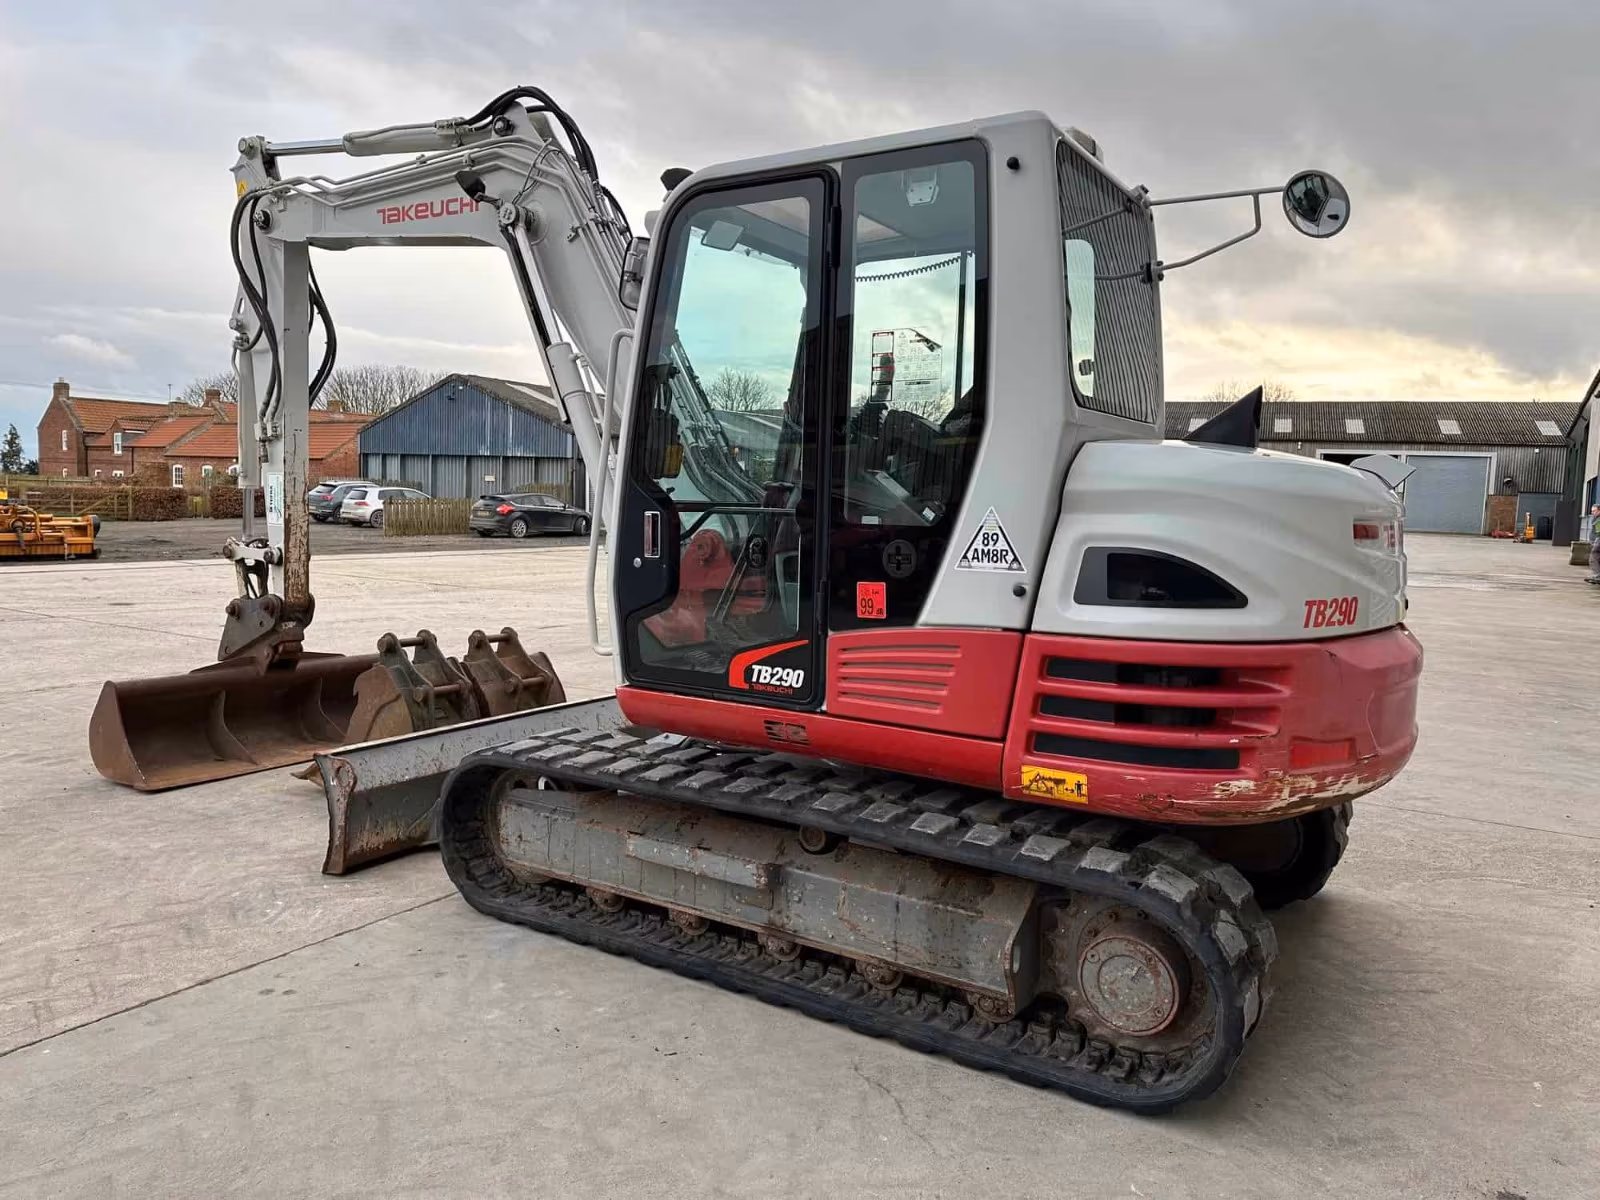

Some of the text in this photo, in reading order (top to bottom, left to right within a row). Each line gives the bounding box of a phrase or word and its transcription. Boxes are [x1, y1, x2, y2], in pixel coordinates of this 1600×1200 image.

[981, 531, 1000, 548] 89
[971, 547, 1009, 565] AM8R
[860, 597, 874, 615] 99
[1303, 596, 1359, 629] TB290
[751, 664, 805, 688] TB290
